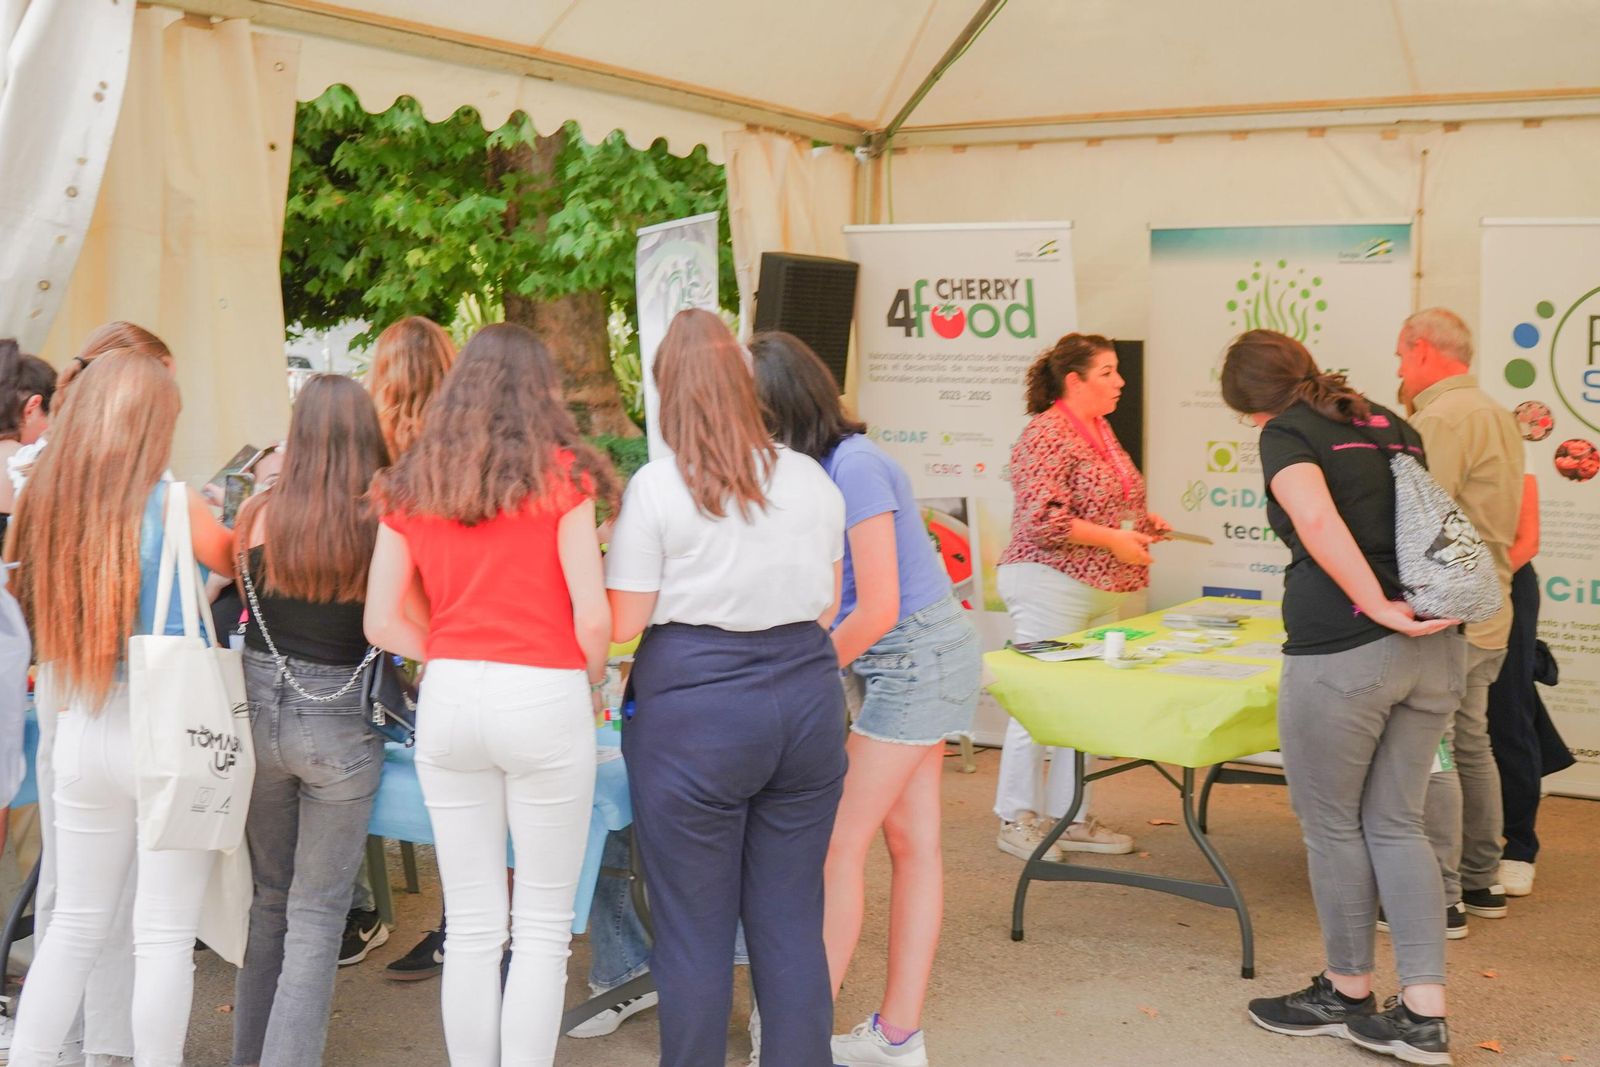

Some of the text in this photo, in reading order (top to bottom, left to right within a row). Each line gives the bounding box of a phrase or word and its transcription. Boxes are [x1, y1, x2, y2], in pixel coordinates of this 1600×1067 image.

[936, 278, 1019, 300] CHERRY
[868, 363, 887, 373] para
[881, 430, 928, 443] CiDAF
[1224, 521, 1279, 542] tecn
[1563, 633, 1576, 641] de
